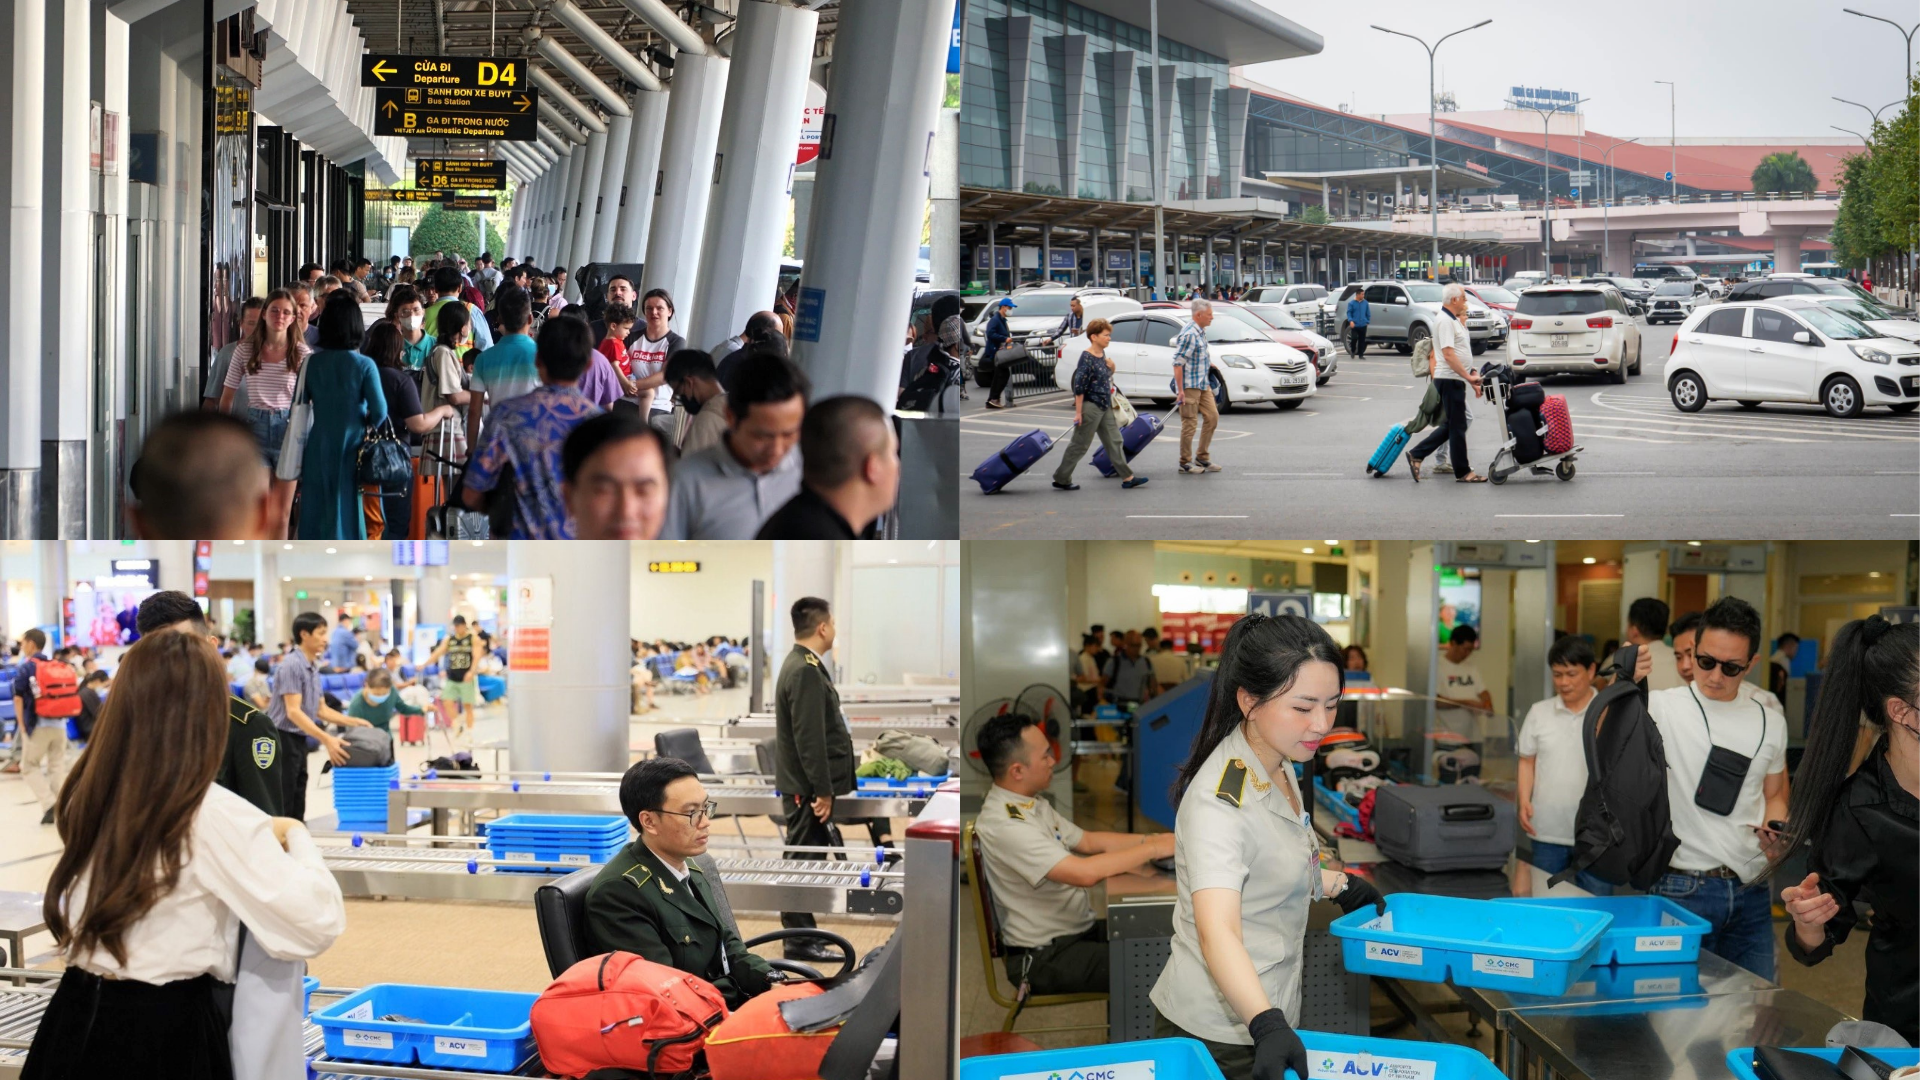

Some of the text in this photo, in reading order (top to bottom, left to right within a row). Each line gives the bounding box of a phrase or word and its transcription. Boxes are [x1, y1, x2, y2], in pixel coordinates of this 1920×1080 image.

[414, 59, 451, 72] CỬA ĐI
[478, 62, 517, 87] D4
[414, 75, 460, 85] Departure
[474, 90, 486, 98] XE
[443, 98, 471, 106] Station
[403, 112, 417, 128] B
[426, 116, 509, 127] GA ĐI TRONG NƯỚC
[426, 126, 505, 137] Domestic Departures
[433, 175, 448, 185] D6
[633, 351, 665, 361] Dickies
[1448, 674, 1474, 687] FILA
[1381, 947, 1399, 957] ACV
[449, 1042, 466, 1050] ACV
[1086, 1070, 1115, 1080] CMC
